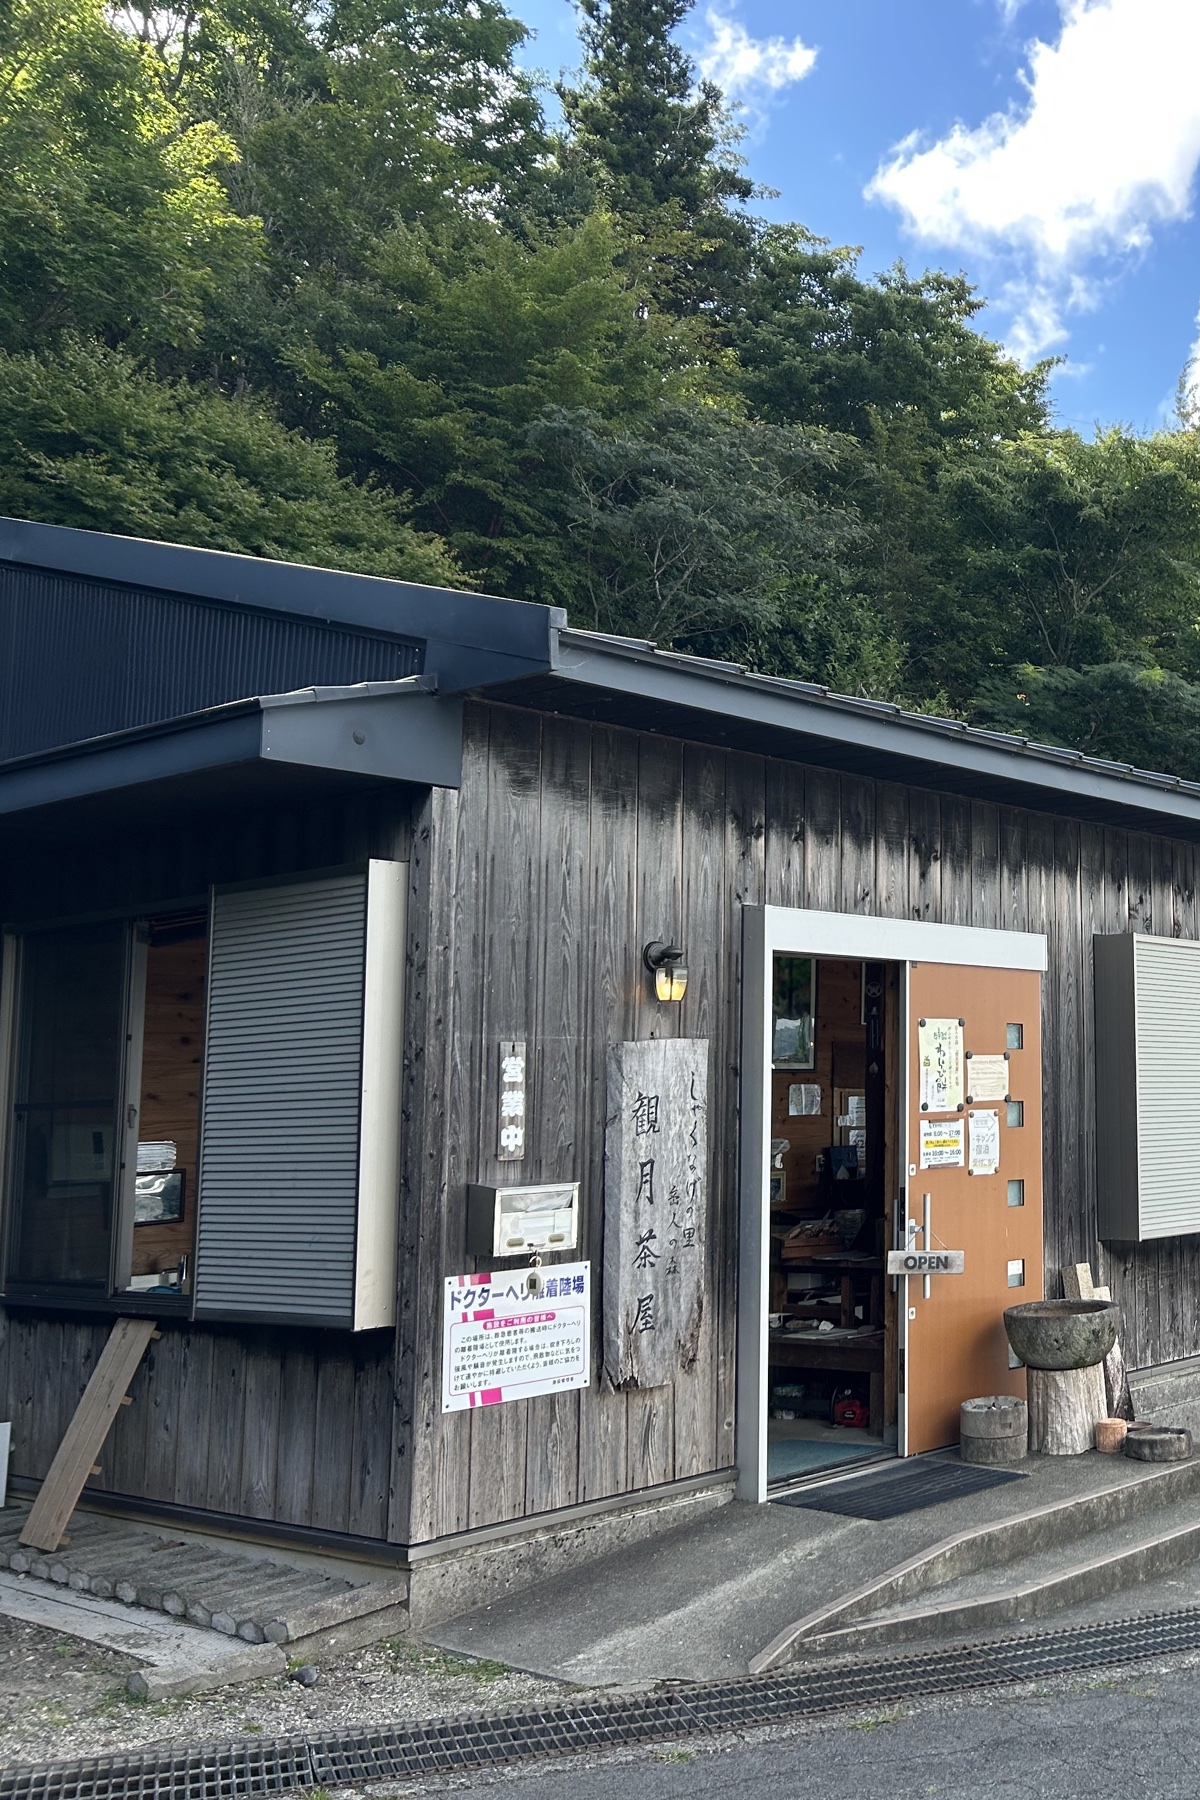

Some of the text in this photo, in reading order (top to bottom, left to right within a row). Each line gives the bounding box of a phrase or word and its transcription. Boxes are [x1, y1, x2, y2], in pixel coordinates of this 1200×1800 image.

[501, 1056, 525, 1152] 営業中
[683, 1071, 702, 1248] しゃくなげの里
[629, 1090, 660, 1334] 観月茶屋
[903, 1255, 949, 1270] OPEN
[486, 1313, 554, 1330] 施設をご利用の皆様へ
[453, 1379, 492, 1391] お願いします。
